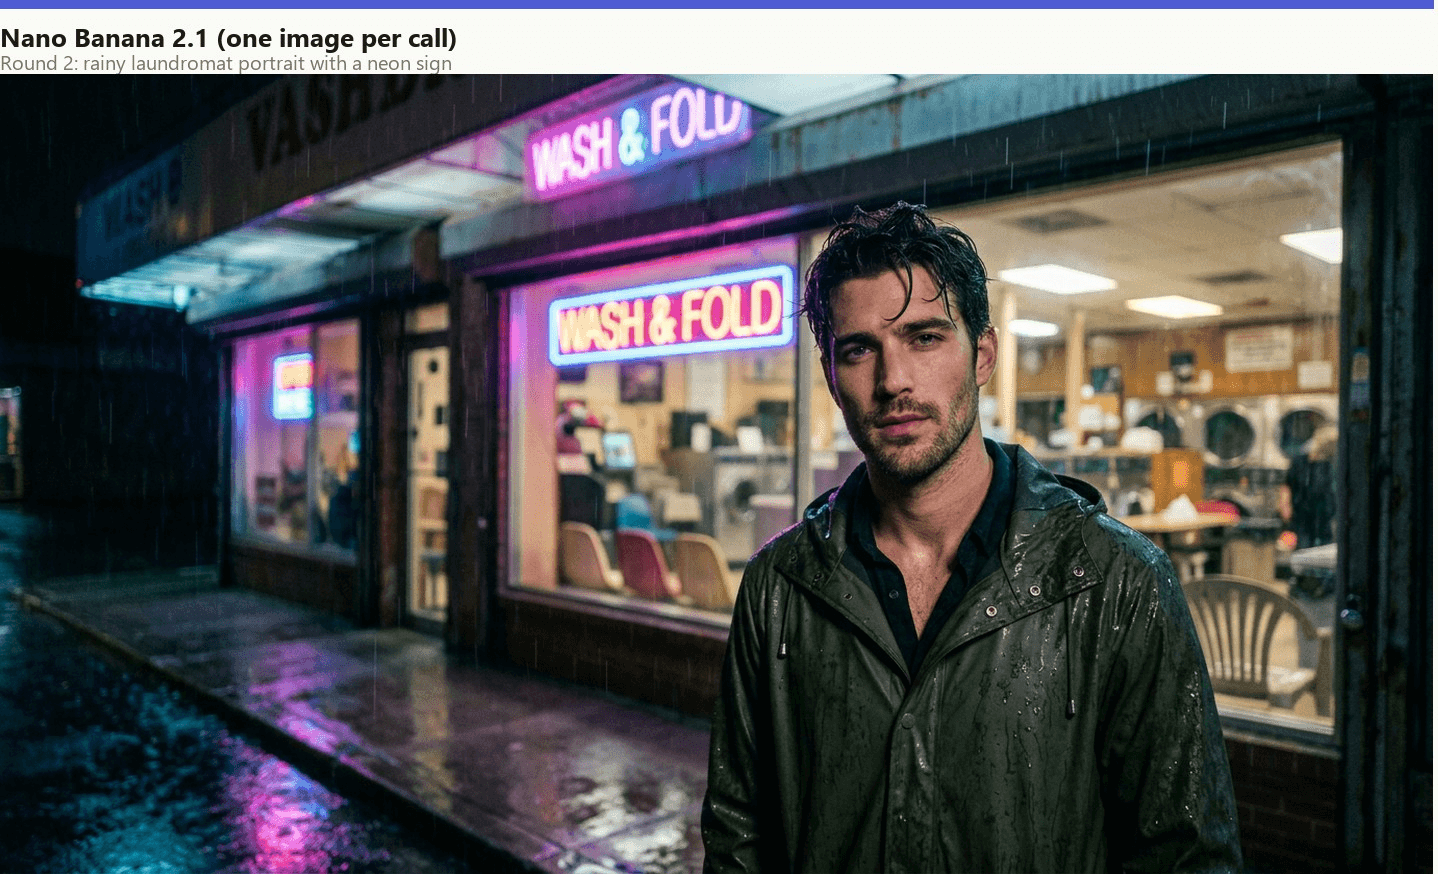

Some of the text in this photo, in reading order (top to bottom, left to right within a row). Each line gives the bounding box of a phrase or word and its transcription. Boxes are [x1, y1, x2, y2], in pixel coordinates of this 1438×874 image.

[532, 116, 622, 192] WASH
[618, 108, 646, 166] &
[558, 279, 783, 354] WASH & FOLD
